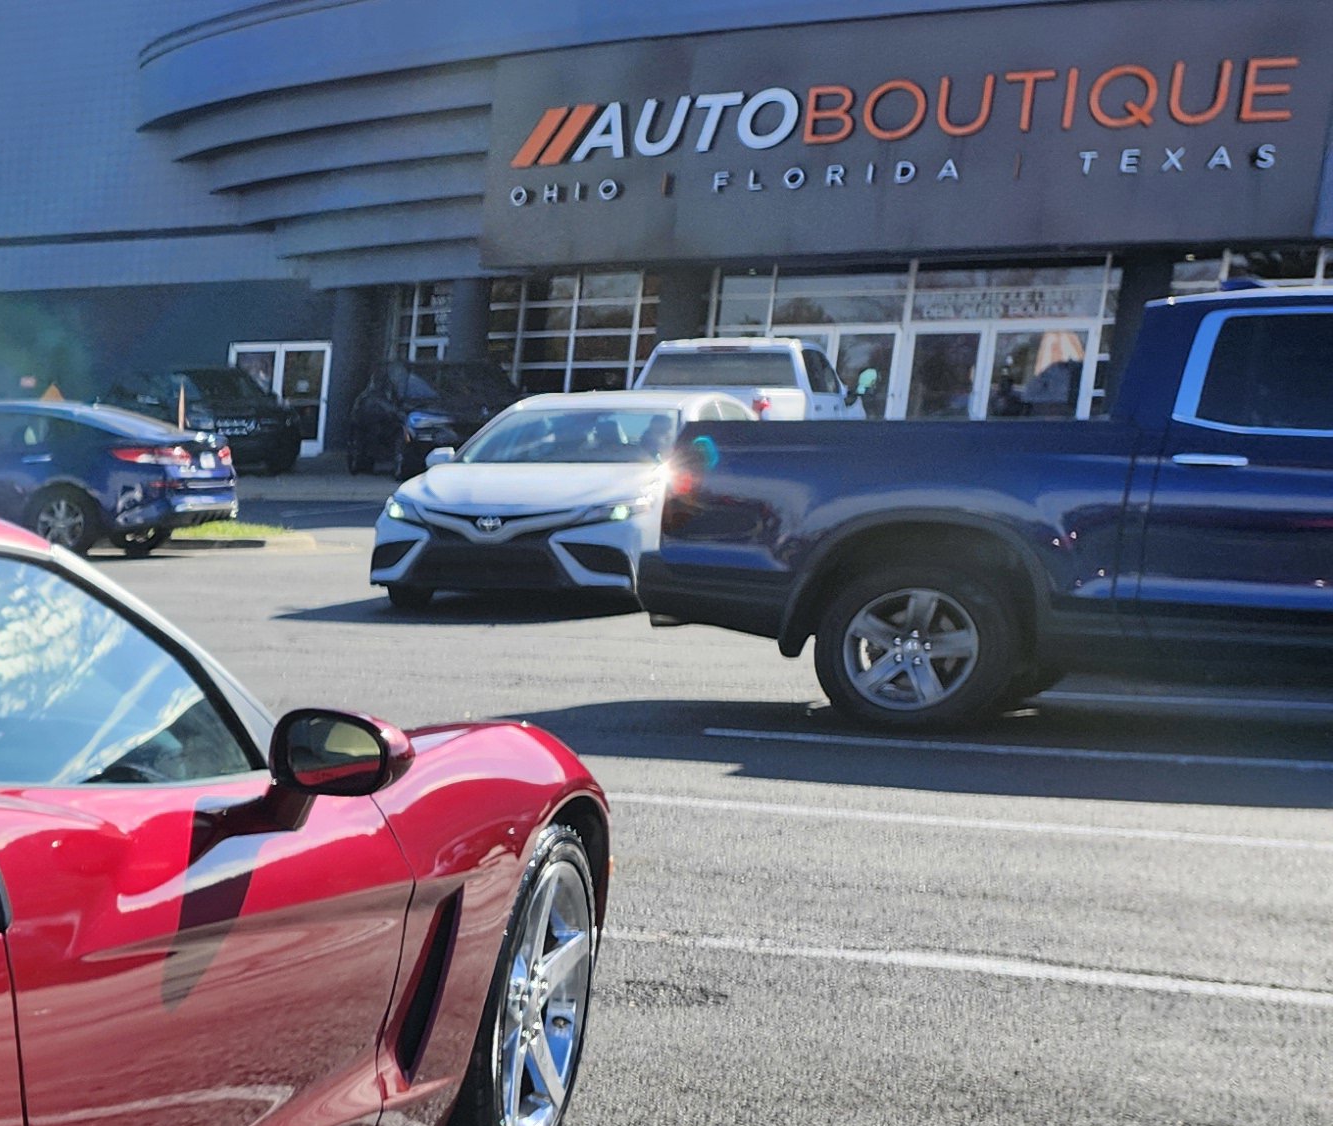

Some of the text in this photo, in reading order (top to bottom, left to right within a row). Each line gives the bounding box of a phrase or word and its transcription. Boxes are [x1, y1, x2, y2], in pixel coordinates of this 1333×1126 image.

[571, 56, 1300, 162] AUTOBOUTIQUE
[510, 144, 1276, 207] OHIO FLORIDA TEXAS
